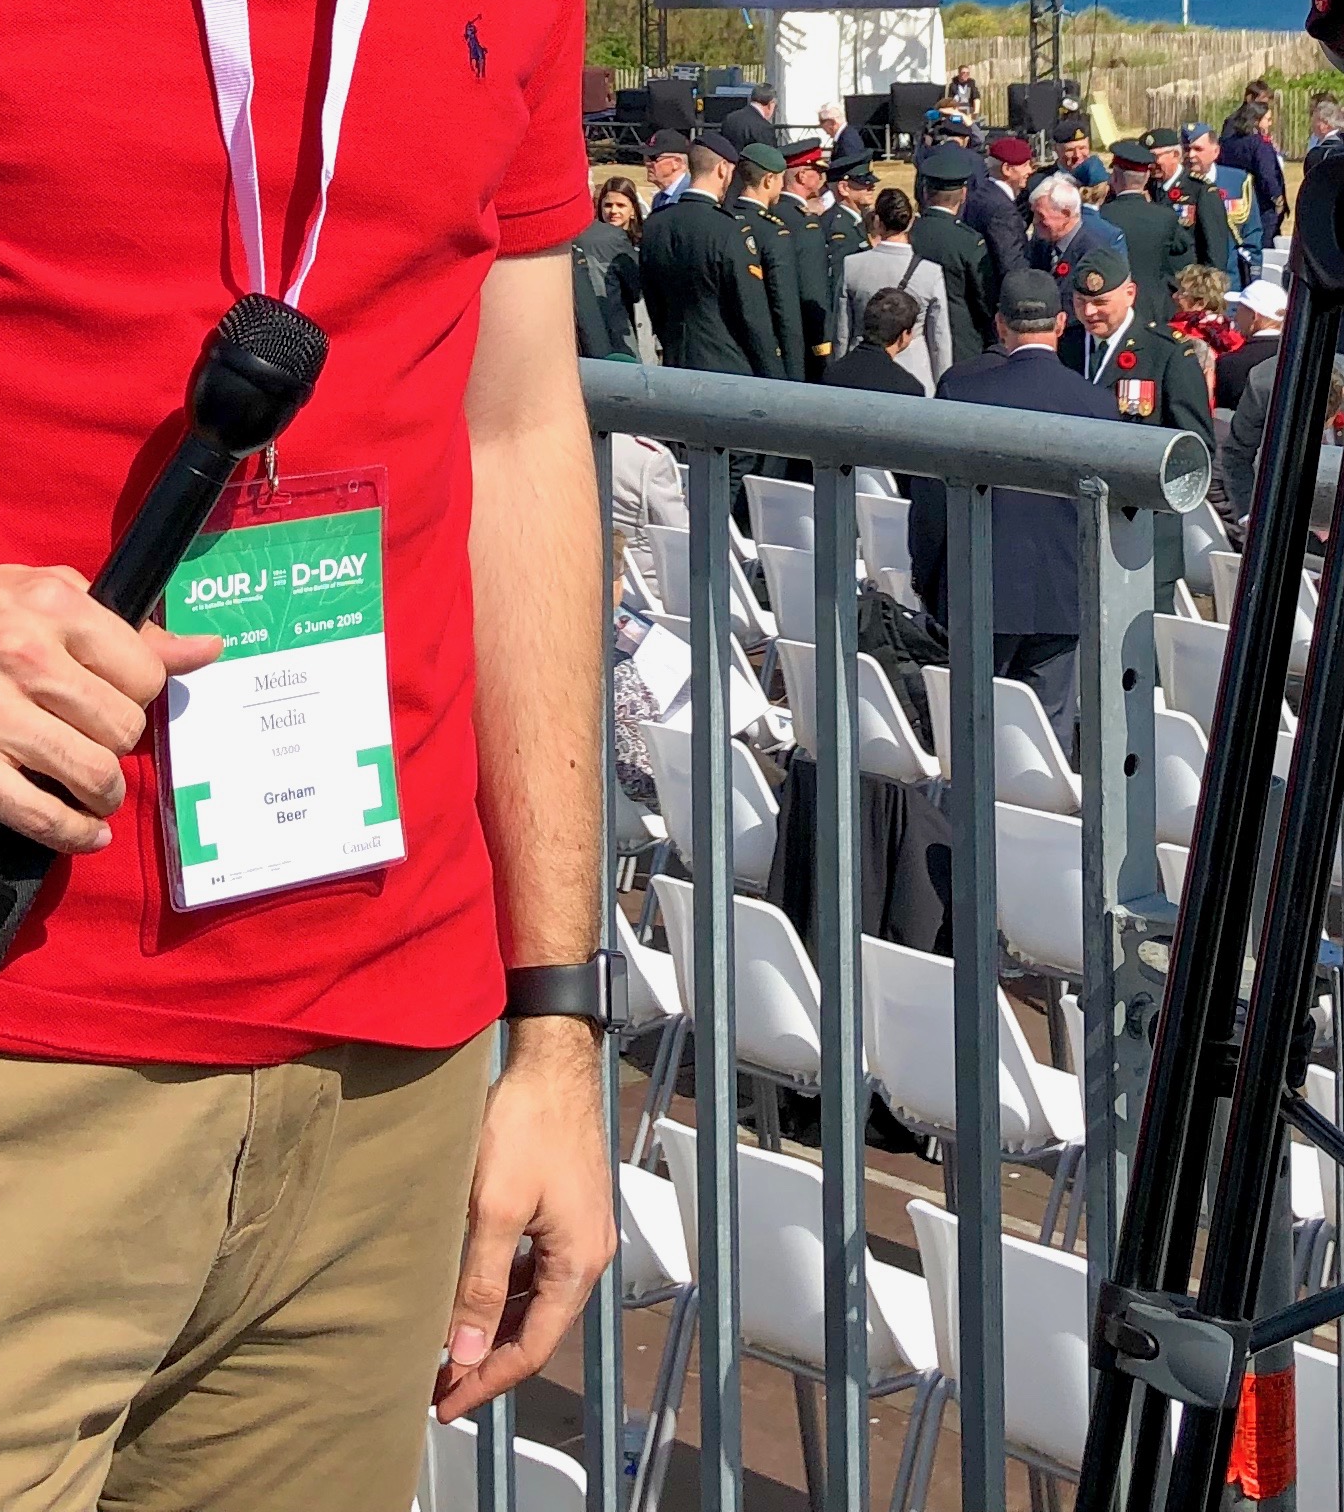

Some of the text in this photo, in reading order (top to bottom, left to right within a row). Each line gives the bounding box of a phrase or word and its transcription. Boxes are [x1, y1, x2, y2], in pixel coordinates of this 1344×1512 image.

[291, 552, 368, 587] D-DAY
[184, 569, 267, 604] JOUR J
[294, 611, 363, 635] 6 June 2019
[241, 628, 268, 646] 2019
[254, 669, 308, 692] Médias
[260, 708, 306, 732] Media
[263, 786, 316, 805] Graham
[276, 808, 307, 824] Beer
[342, 835, 382, 855] Canada
